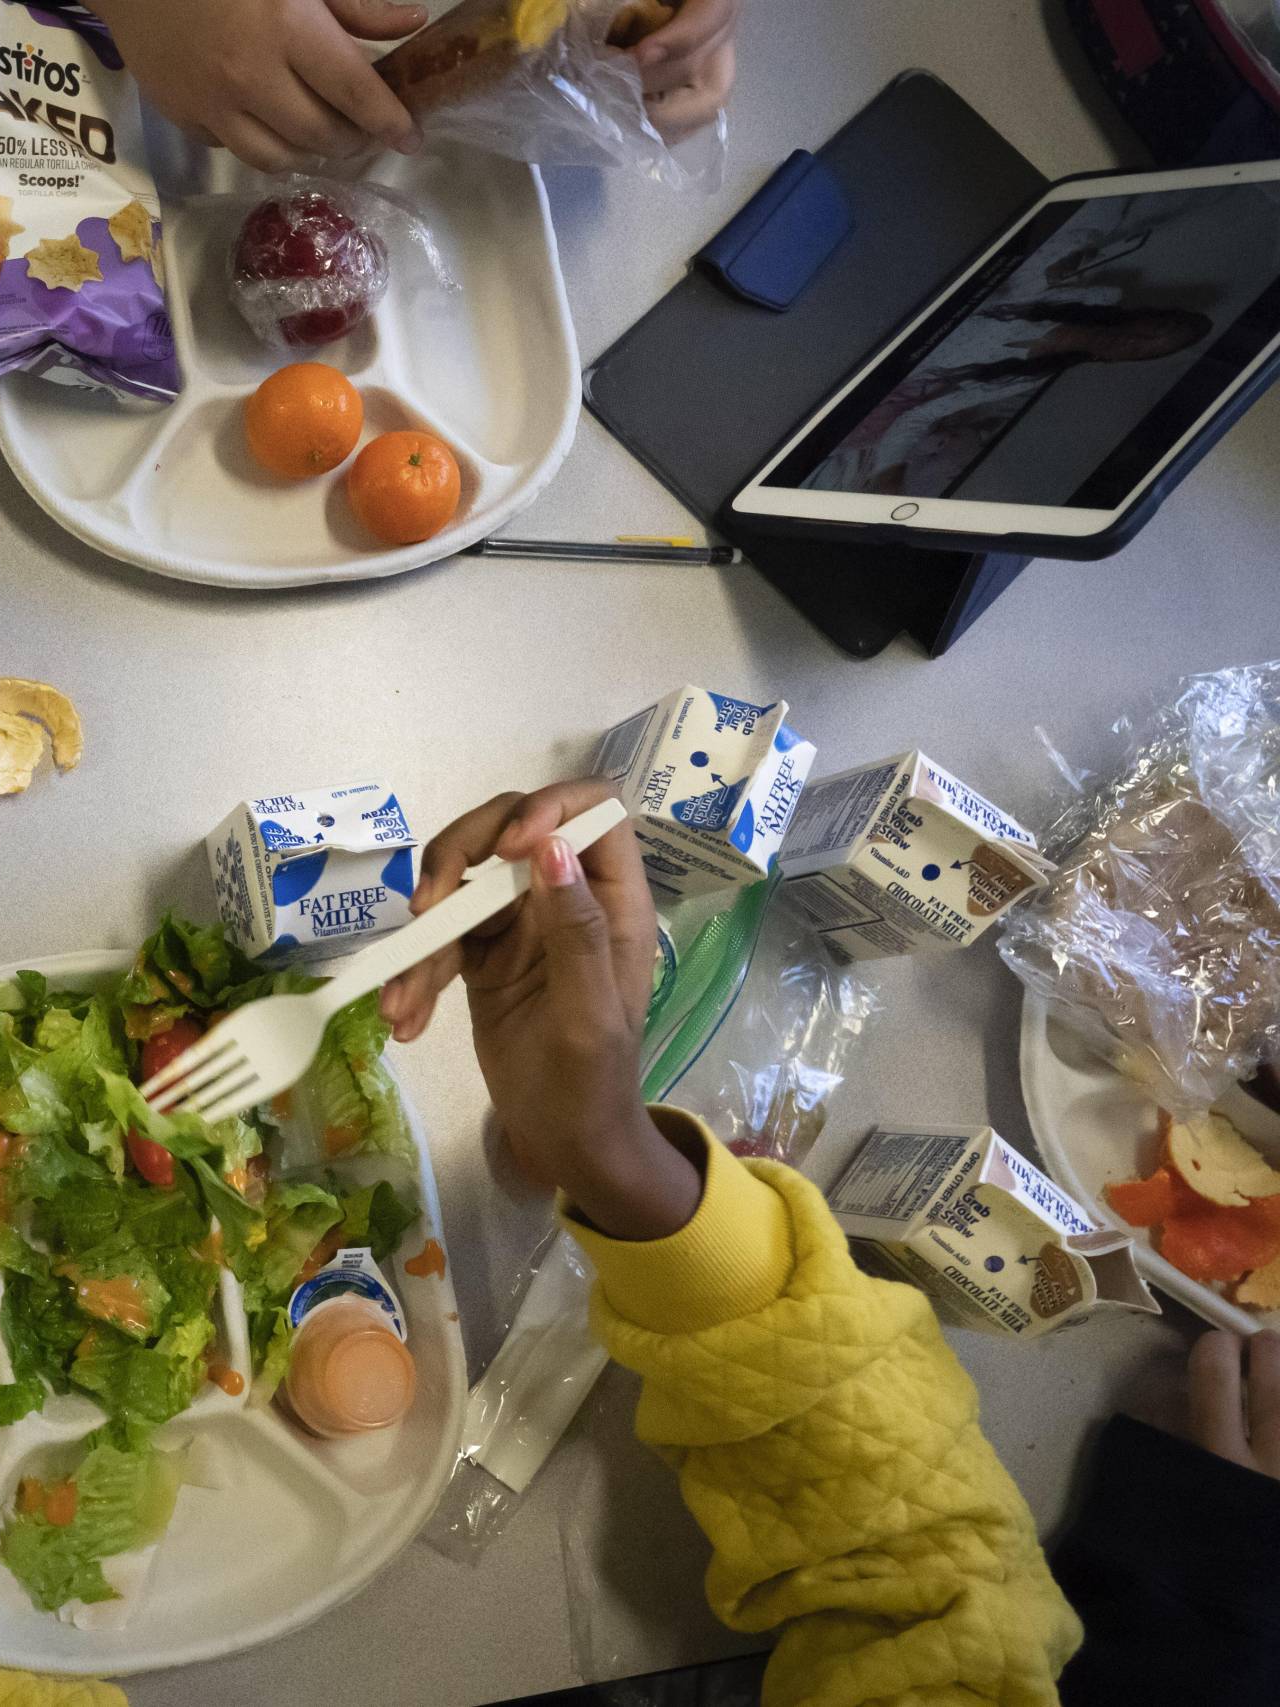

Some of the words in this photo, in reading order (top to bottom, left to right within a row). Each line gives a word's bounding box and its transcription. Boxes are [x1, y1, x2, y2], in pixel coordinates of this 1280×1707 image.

[31, 137, 68, 156] LESS
[10, 158, 45, 169] REGULAR
[47, 159, 80, 170] TORTILLA
[18, 173, 80, 190] Scoops!
[18, 189, 54, 197] TORTILLA
[676, 697, 694, 725] Vitamins
[714, 700, 733, 733] Straw
[730, 705, 749, 731] Your
[742, 708, 760, 736] Grab
[662, 764, 677, 787] FAT
[894, 773, 911, 799] OPEN
[927, 768, 959, 796] MILK
[253, 794, 294, 808] MILK
[331, 789, 349, 799] A&D
[349, 783, 380, 796] Vitamins
[640, 770, 658, 810] MILK
[653, 787, 668, 813] FREE
[755, 801, 777, 837] FAT
[768, 756, 795, 801] FREE
[252, 803, 286, 814] FREE
[287, 800, 305, 812] FAT
[361, 806, 400, 820] Straw
[680, 795, 699, 821] Here
[693, 791, 717, 823] Punch
[707, 804, 723, 828] And
[770, 776, 799, 834] MILK
[877, 797, 897, 825] OTHER
[896, 805, 924, 828] Grab
[949, 797, 979, 822] FREE
[957, 793, 1031, 843] CHOCOLATE
[370, 817, 402, 830] Your
[375, 830, 406, 842] Grab
[889, 814, 914, 837] Your
[981, 820, 1004, 838] FAT
[879, 824, 911, 851] Straw
[870, 847, 895, 870] Vitamins
[893, 865, 911, 880] A&D
[970, 871, 1006, 901] Punch
[994, 872, 1017, 892] And
[299, 895, 337, 915] FAT
[339, 886, 387, 906] FREE
[967, 886, 996, 911] Here
[312, 904, 377, 930] MILK
[886, 881, 941, 926] CHOCOLATE
[939, 918, 968, 943] MILK
[927, 895, 949, 914] FAT
[947, 907, 975, 931] FREE
[313, 925, 351, 937] Vitamins
[353, 919, 375, 931] A&D
[961, 1151, 980, 1175] OPEN
[1000, 1150, 1033, 1184] MILK
[940, 1173, 964, 1202] OTHER
[1022, 1183, 1051, 1212] FREE
[926, 1200, 945, 1222] SIDE
[952, 1202, 981, 1225] Your
[962, 1191, 991, 1218] Grab
[1034, 1183, 1093, 1235] HOCOLATE
[940, 1210, 975, 1239] Straw
[928, 1231, 955, 1255] Vitamins
[952, 1250, 971, 1266] A&D
[943, 1265, 1000, 1313] CHOCOLATE
[994, 1306, 1027, 1333] MILK
[986, 1284, 1011, 1305] FAT
[1030, 1284, 1048, 1313] Here
[1035, 1268, 1060, 1310] Punch
